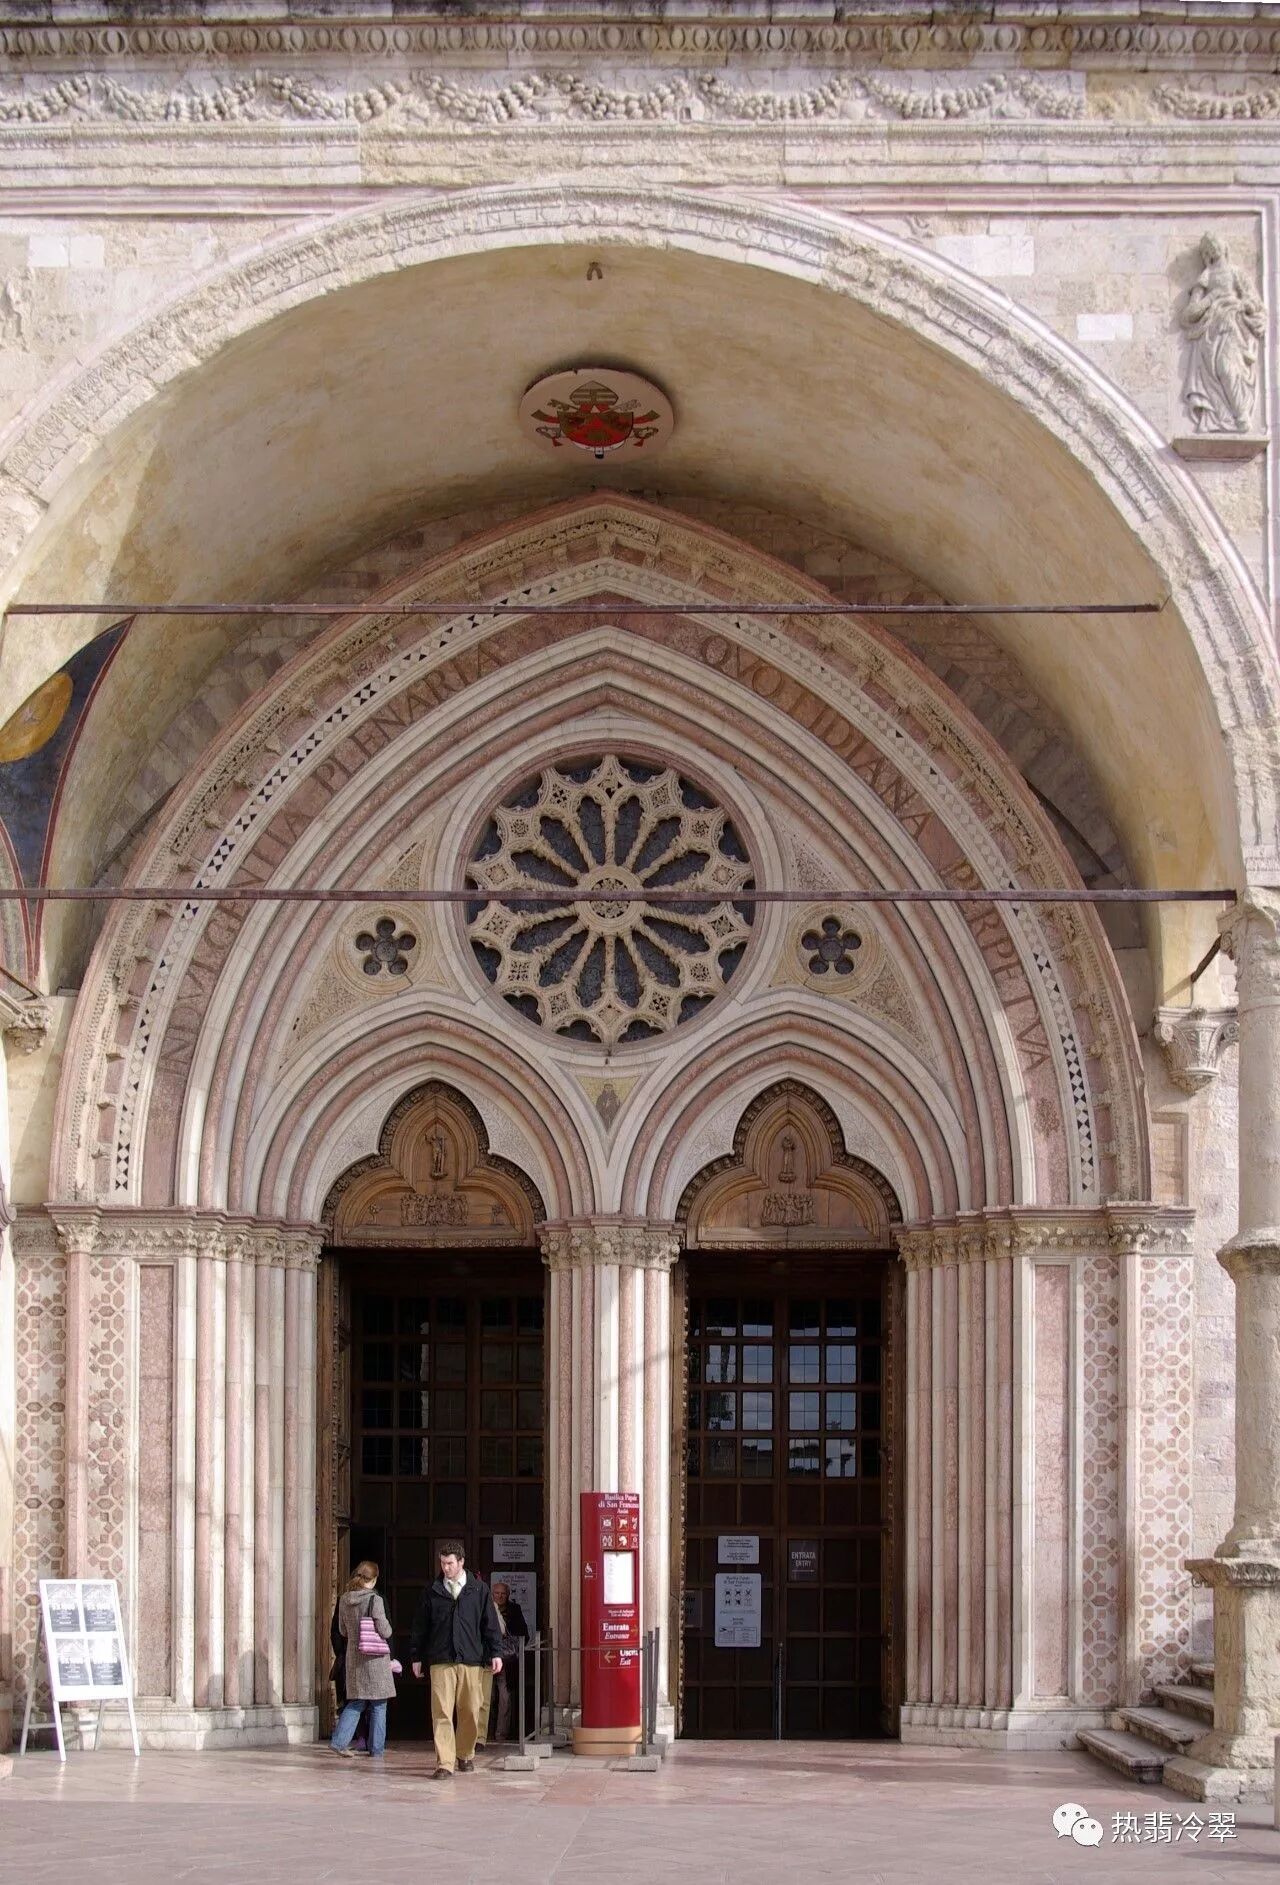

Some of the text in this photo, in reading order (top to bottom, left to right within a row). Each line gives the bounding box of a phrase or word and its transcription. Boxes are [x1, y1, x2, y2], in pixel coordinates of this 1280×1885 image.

[313, 639, 504, 797] PLENARIA
[701, 634, 935, 842] QVOTIDIANA
[940, 856, 1053, 1071] PRPETVA
[606, 1500, 618, 1508] San
[791, 1551, 816, 1560] ENTRATA
[795, 1560, 812, 1568] ENTRY
[602, 1622, 630, 1631] Entrata
